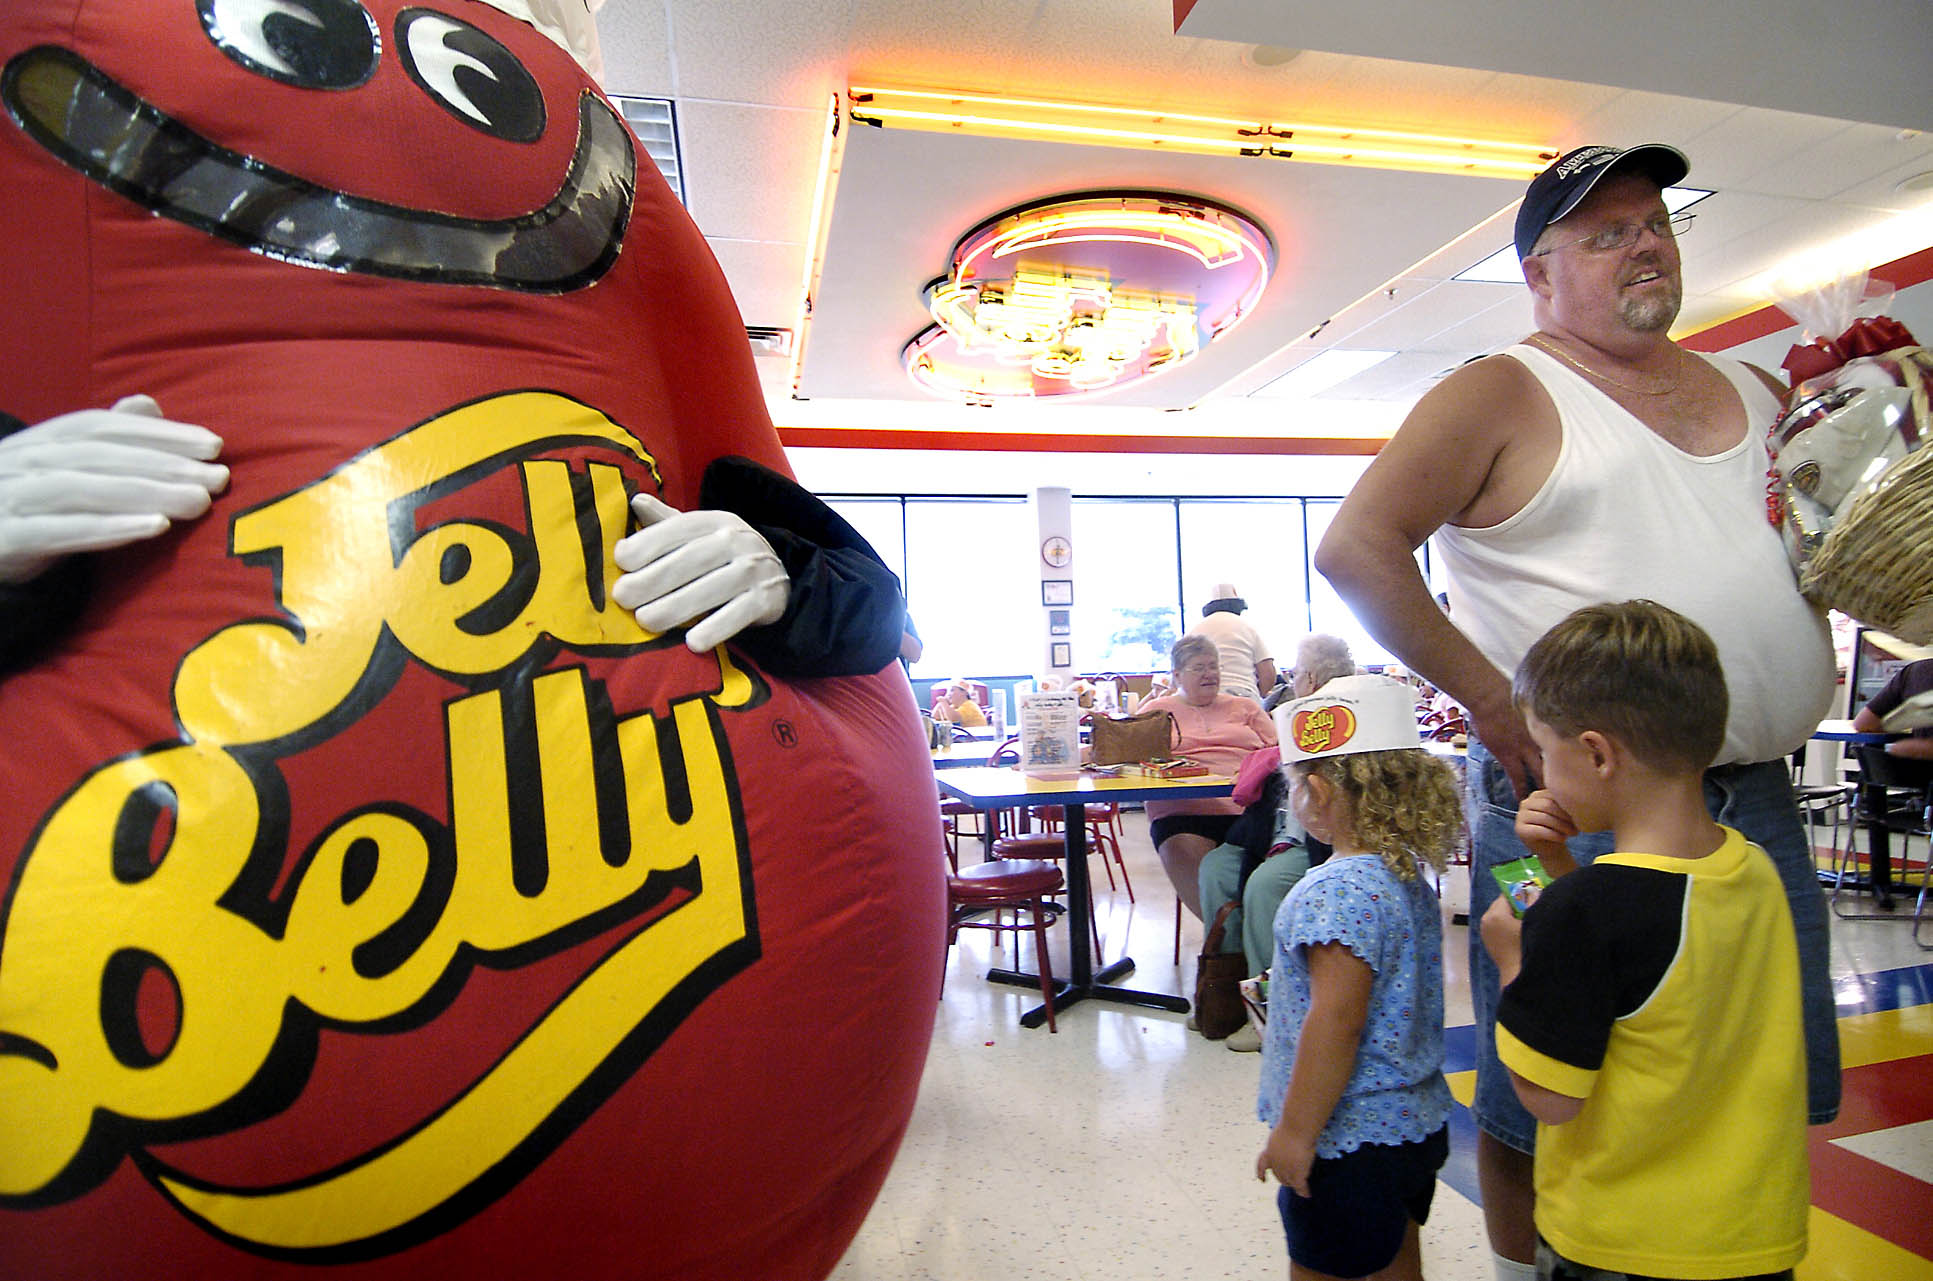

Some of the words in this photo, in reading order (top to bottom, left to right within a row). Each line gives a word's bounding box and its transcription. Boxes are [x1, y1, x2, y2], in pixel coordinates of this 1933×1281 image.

[171, 388, 768, 748] Jell
[1299, 729, 1331, 753] Belly
[1304, 706, 1335, 731] Jelly
[0, 664, 762, 1265] Belly
